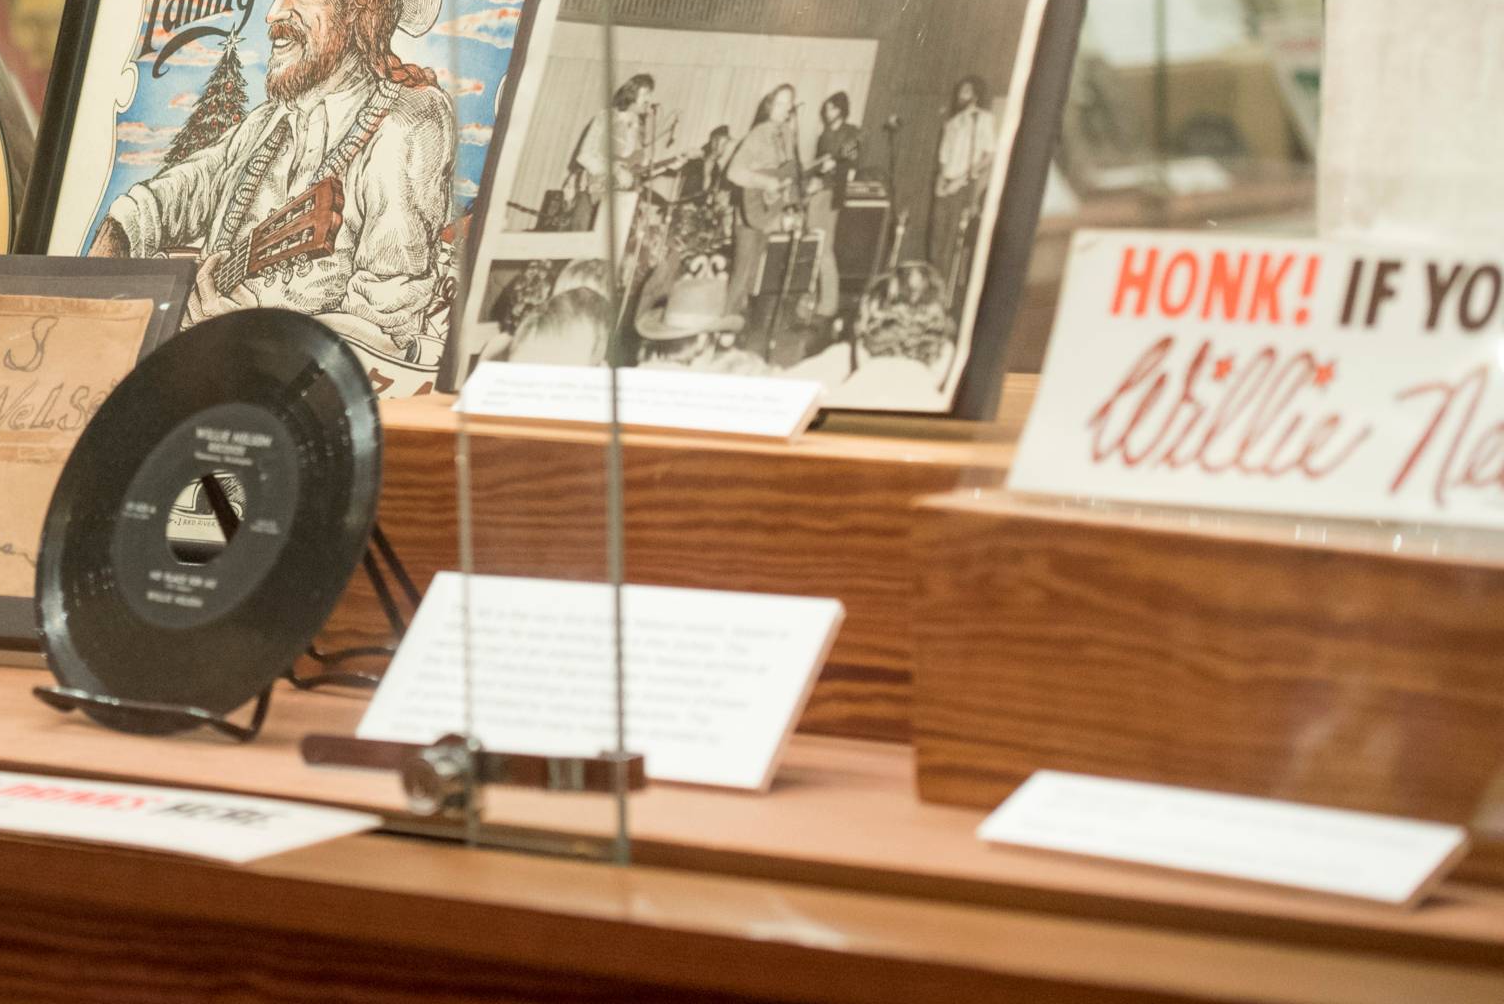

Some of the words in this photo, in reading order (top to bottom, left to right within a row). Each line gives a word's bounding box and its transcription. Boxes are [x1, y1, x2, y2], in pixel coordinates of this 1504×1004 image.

[1109, 246, 1320, 327] HONK!
[1338, 257, 1403, 329] IF
[1424, 261, 1504, 333] YO
